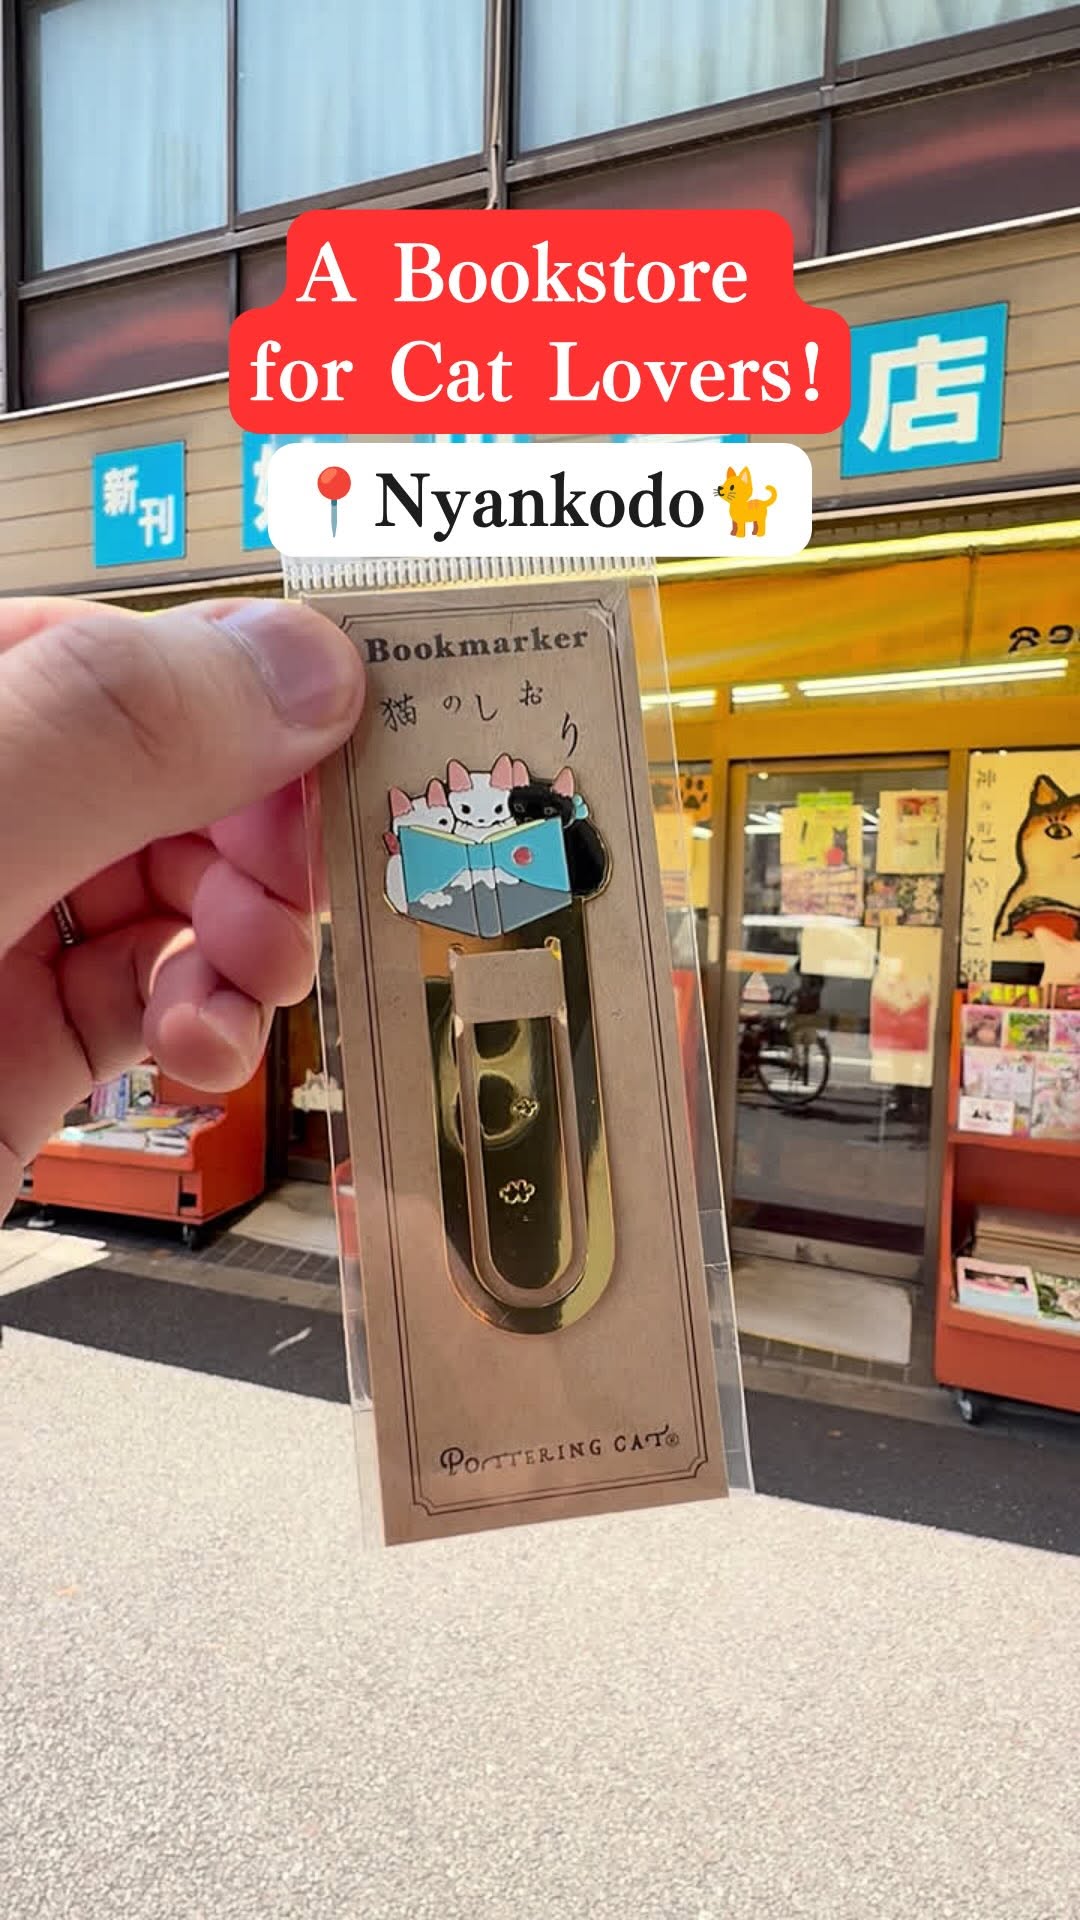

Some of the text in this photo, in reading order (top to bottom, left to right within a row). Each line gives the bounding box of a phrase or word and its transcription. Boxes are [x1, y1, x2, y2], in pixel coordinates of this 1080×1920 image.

[858, 334, 988, 453] 店
[103, 464, 175, 548] 新刊
[364, 626, 590, 664] Bookmarker
[440, 1438, 601, 1476] POTTERING
